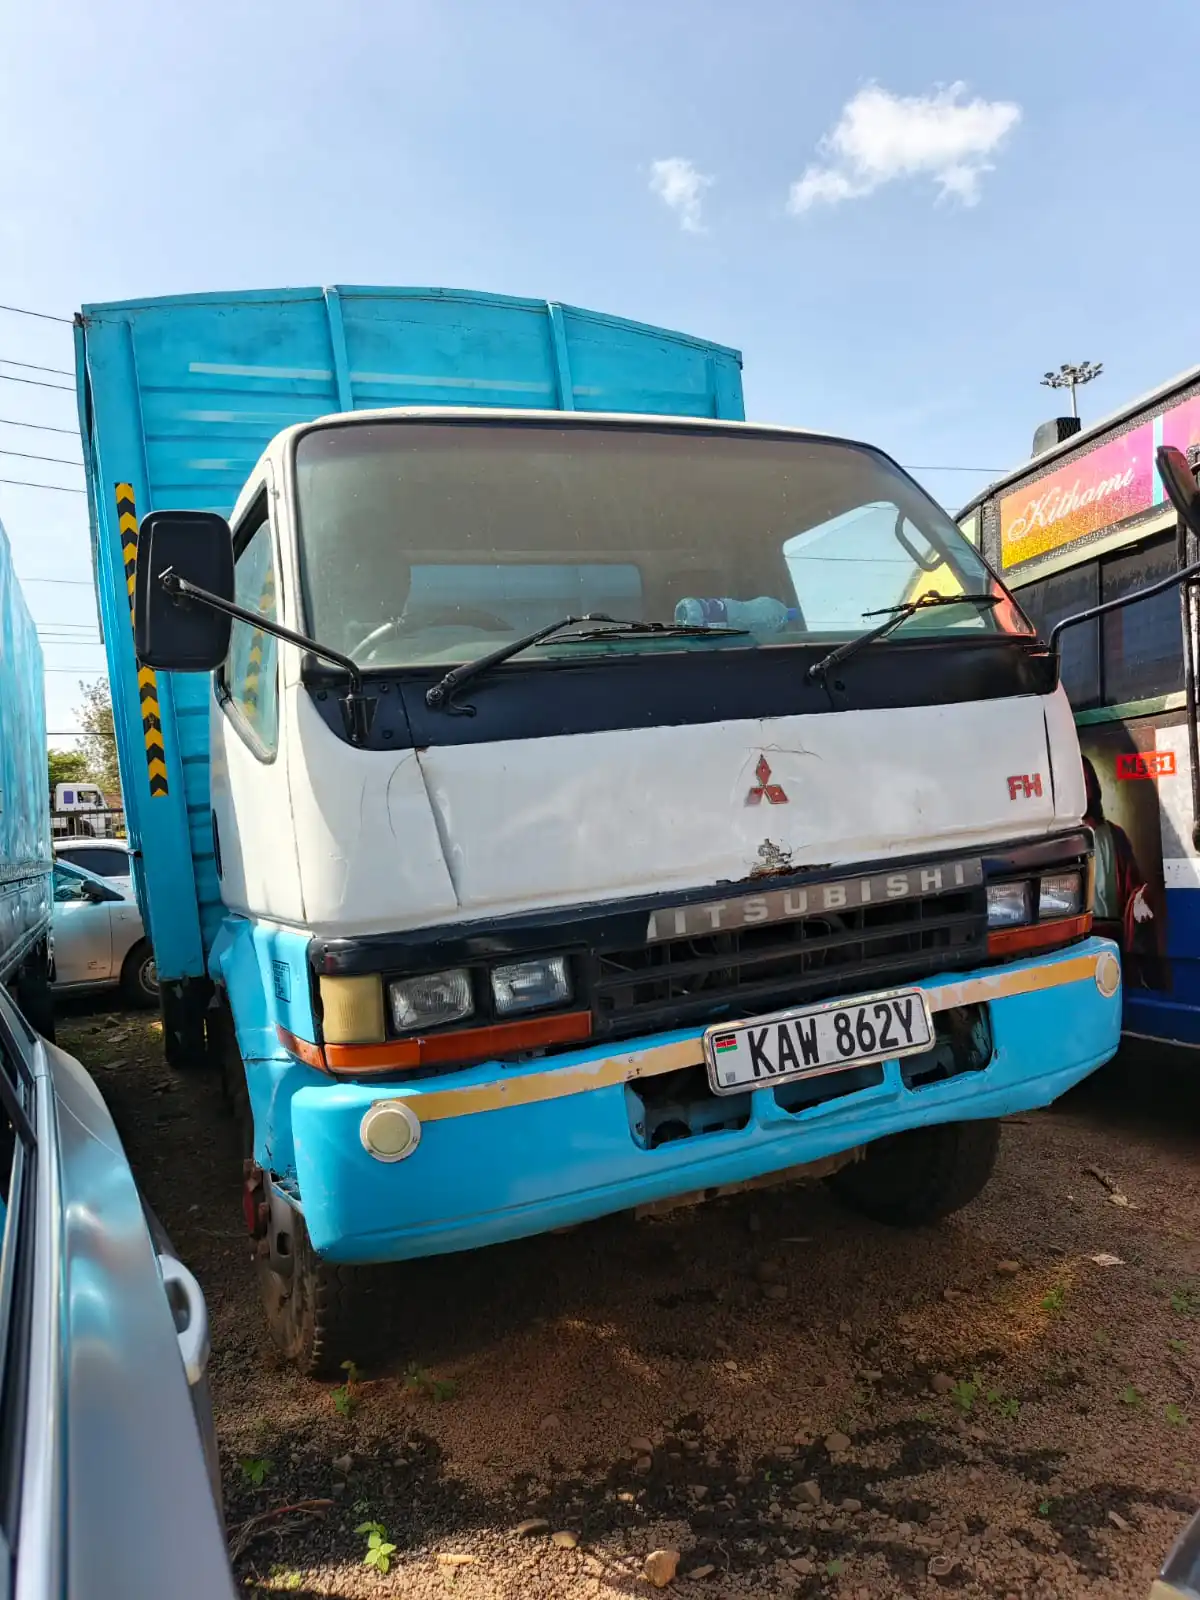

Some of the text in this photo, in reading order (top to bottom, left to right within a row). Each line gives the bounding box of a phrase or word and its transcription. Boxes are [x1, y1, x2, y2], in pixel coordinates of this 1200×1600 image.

[1007, 457, 1137, 542] Kithami
[1007, 772, 1042, 800] FH
[748, 998, 914, 1077] KAW 862Y
